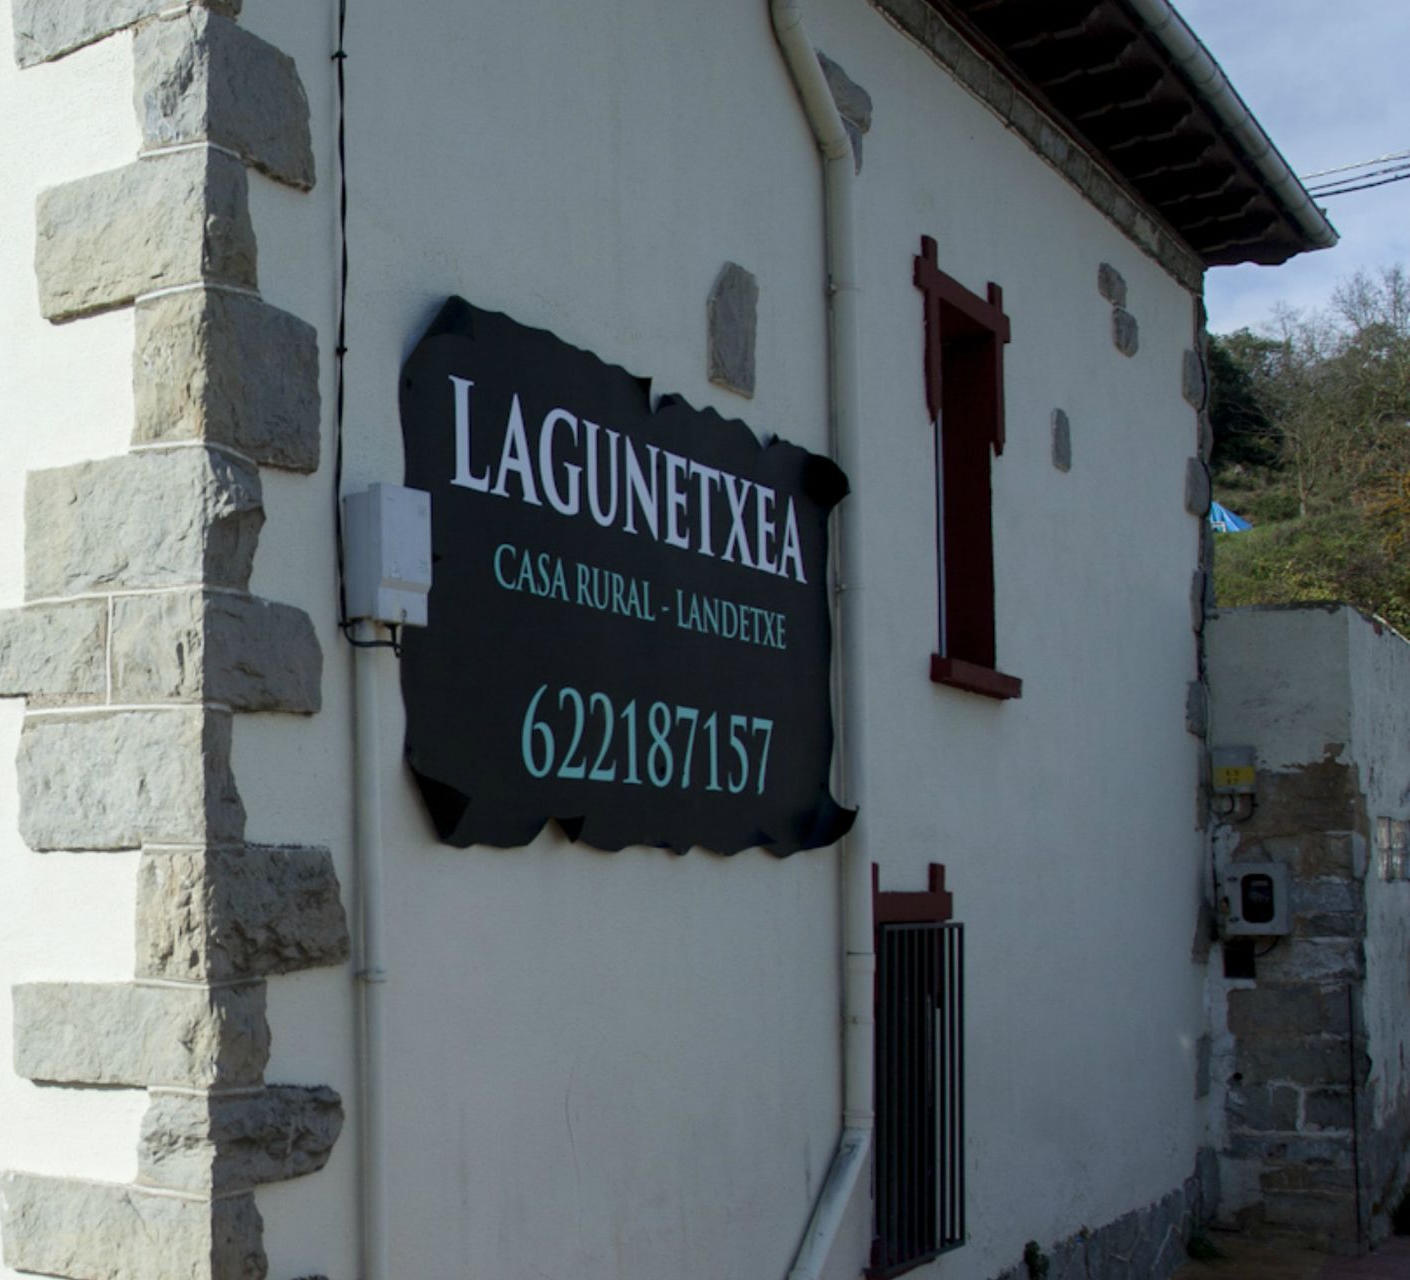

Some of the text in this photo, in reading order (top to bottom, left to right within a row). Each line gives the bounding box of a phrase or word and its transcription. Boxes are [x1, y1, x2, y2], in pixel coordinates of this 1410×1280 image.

[448, 374, 808, 584] LAGUNETXEA
[493, 543, 570, 602] CASA
[576, 562, 656, 622] RURAL
[676, 588, 787, 650] LANDETXE
[521, 684, 774, 795] 622187157
